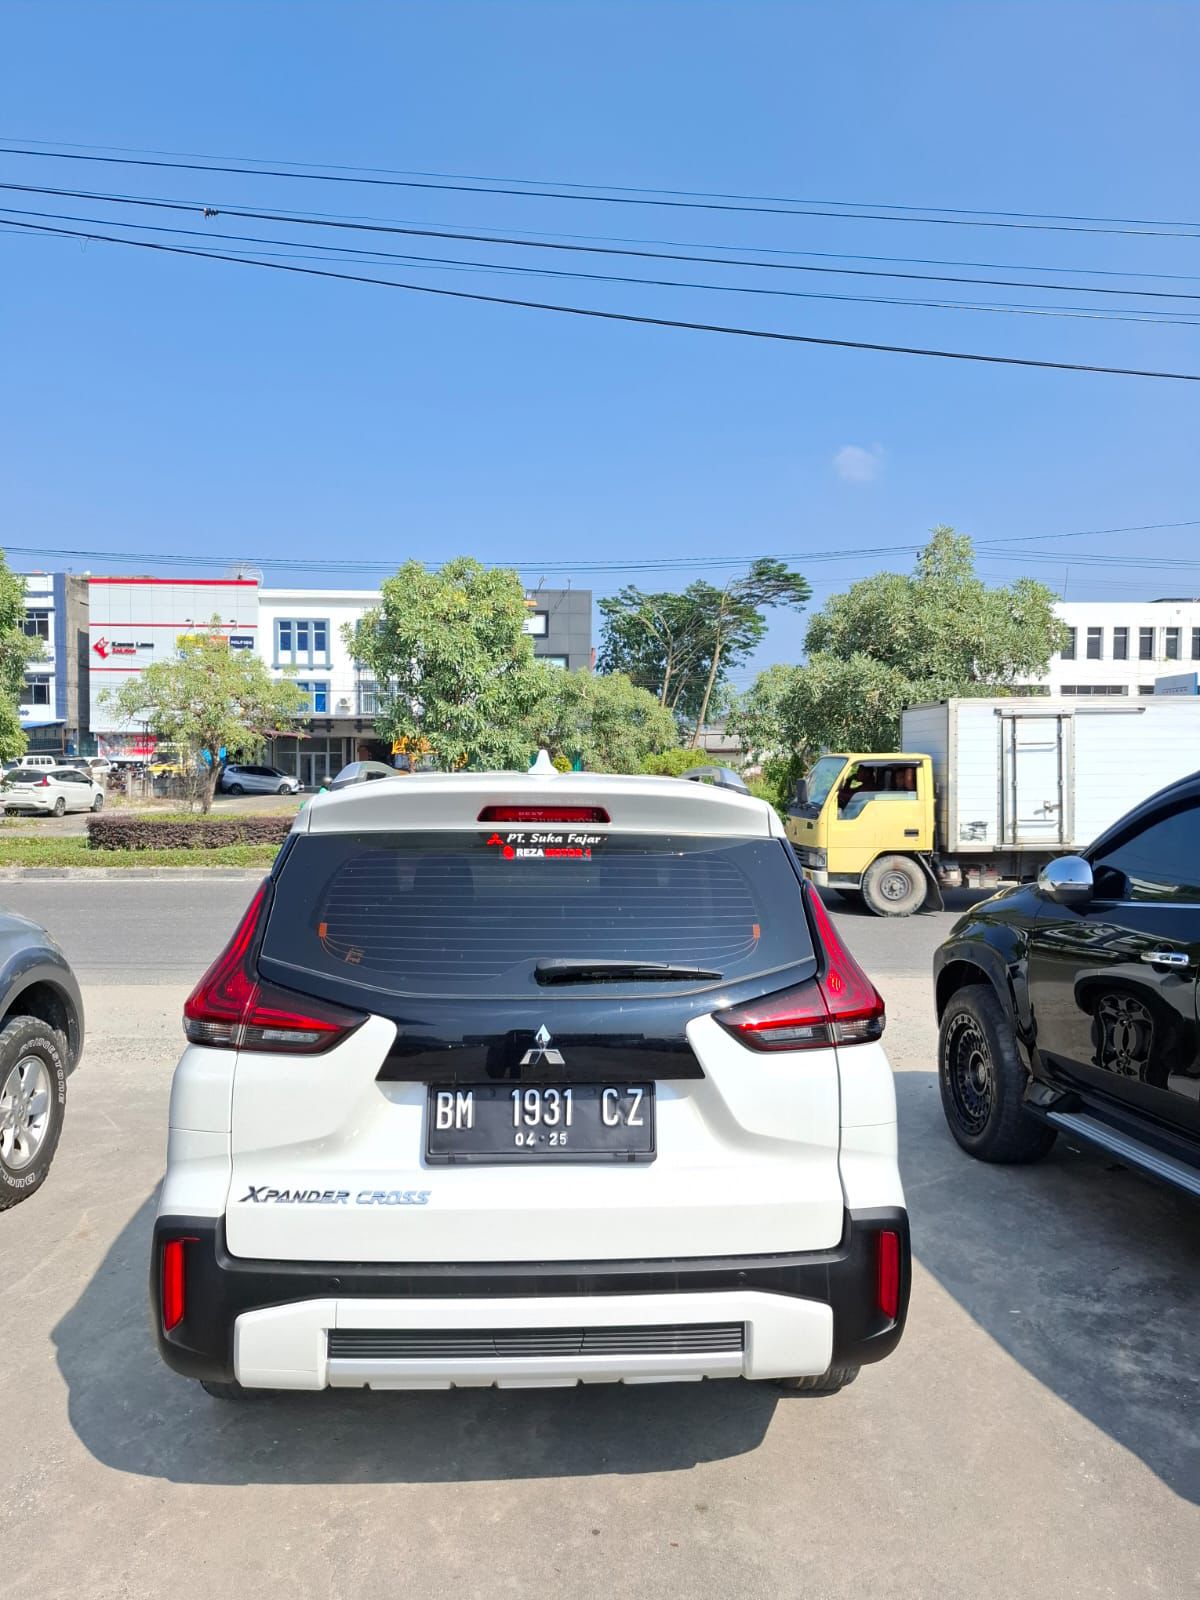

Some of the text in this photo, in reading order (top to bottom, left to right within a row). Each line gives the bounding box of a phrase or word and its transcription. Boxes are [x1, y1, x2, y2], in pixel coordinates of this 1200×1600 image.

[507, 833, 600, 846] PT. Suka Fajar
[516, 848, 544, 857] REZA
[436, 1087, 643, 1130] BM 1931 CZ
[515, 1132, 568, 1146] 04 25
[239, 1185, 432, 1205] XPANDER CROSS
